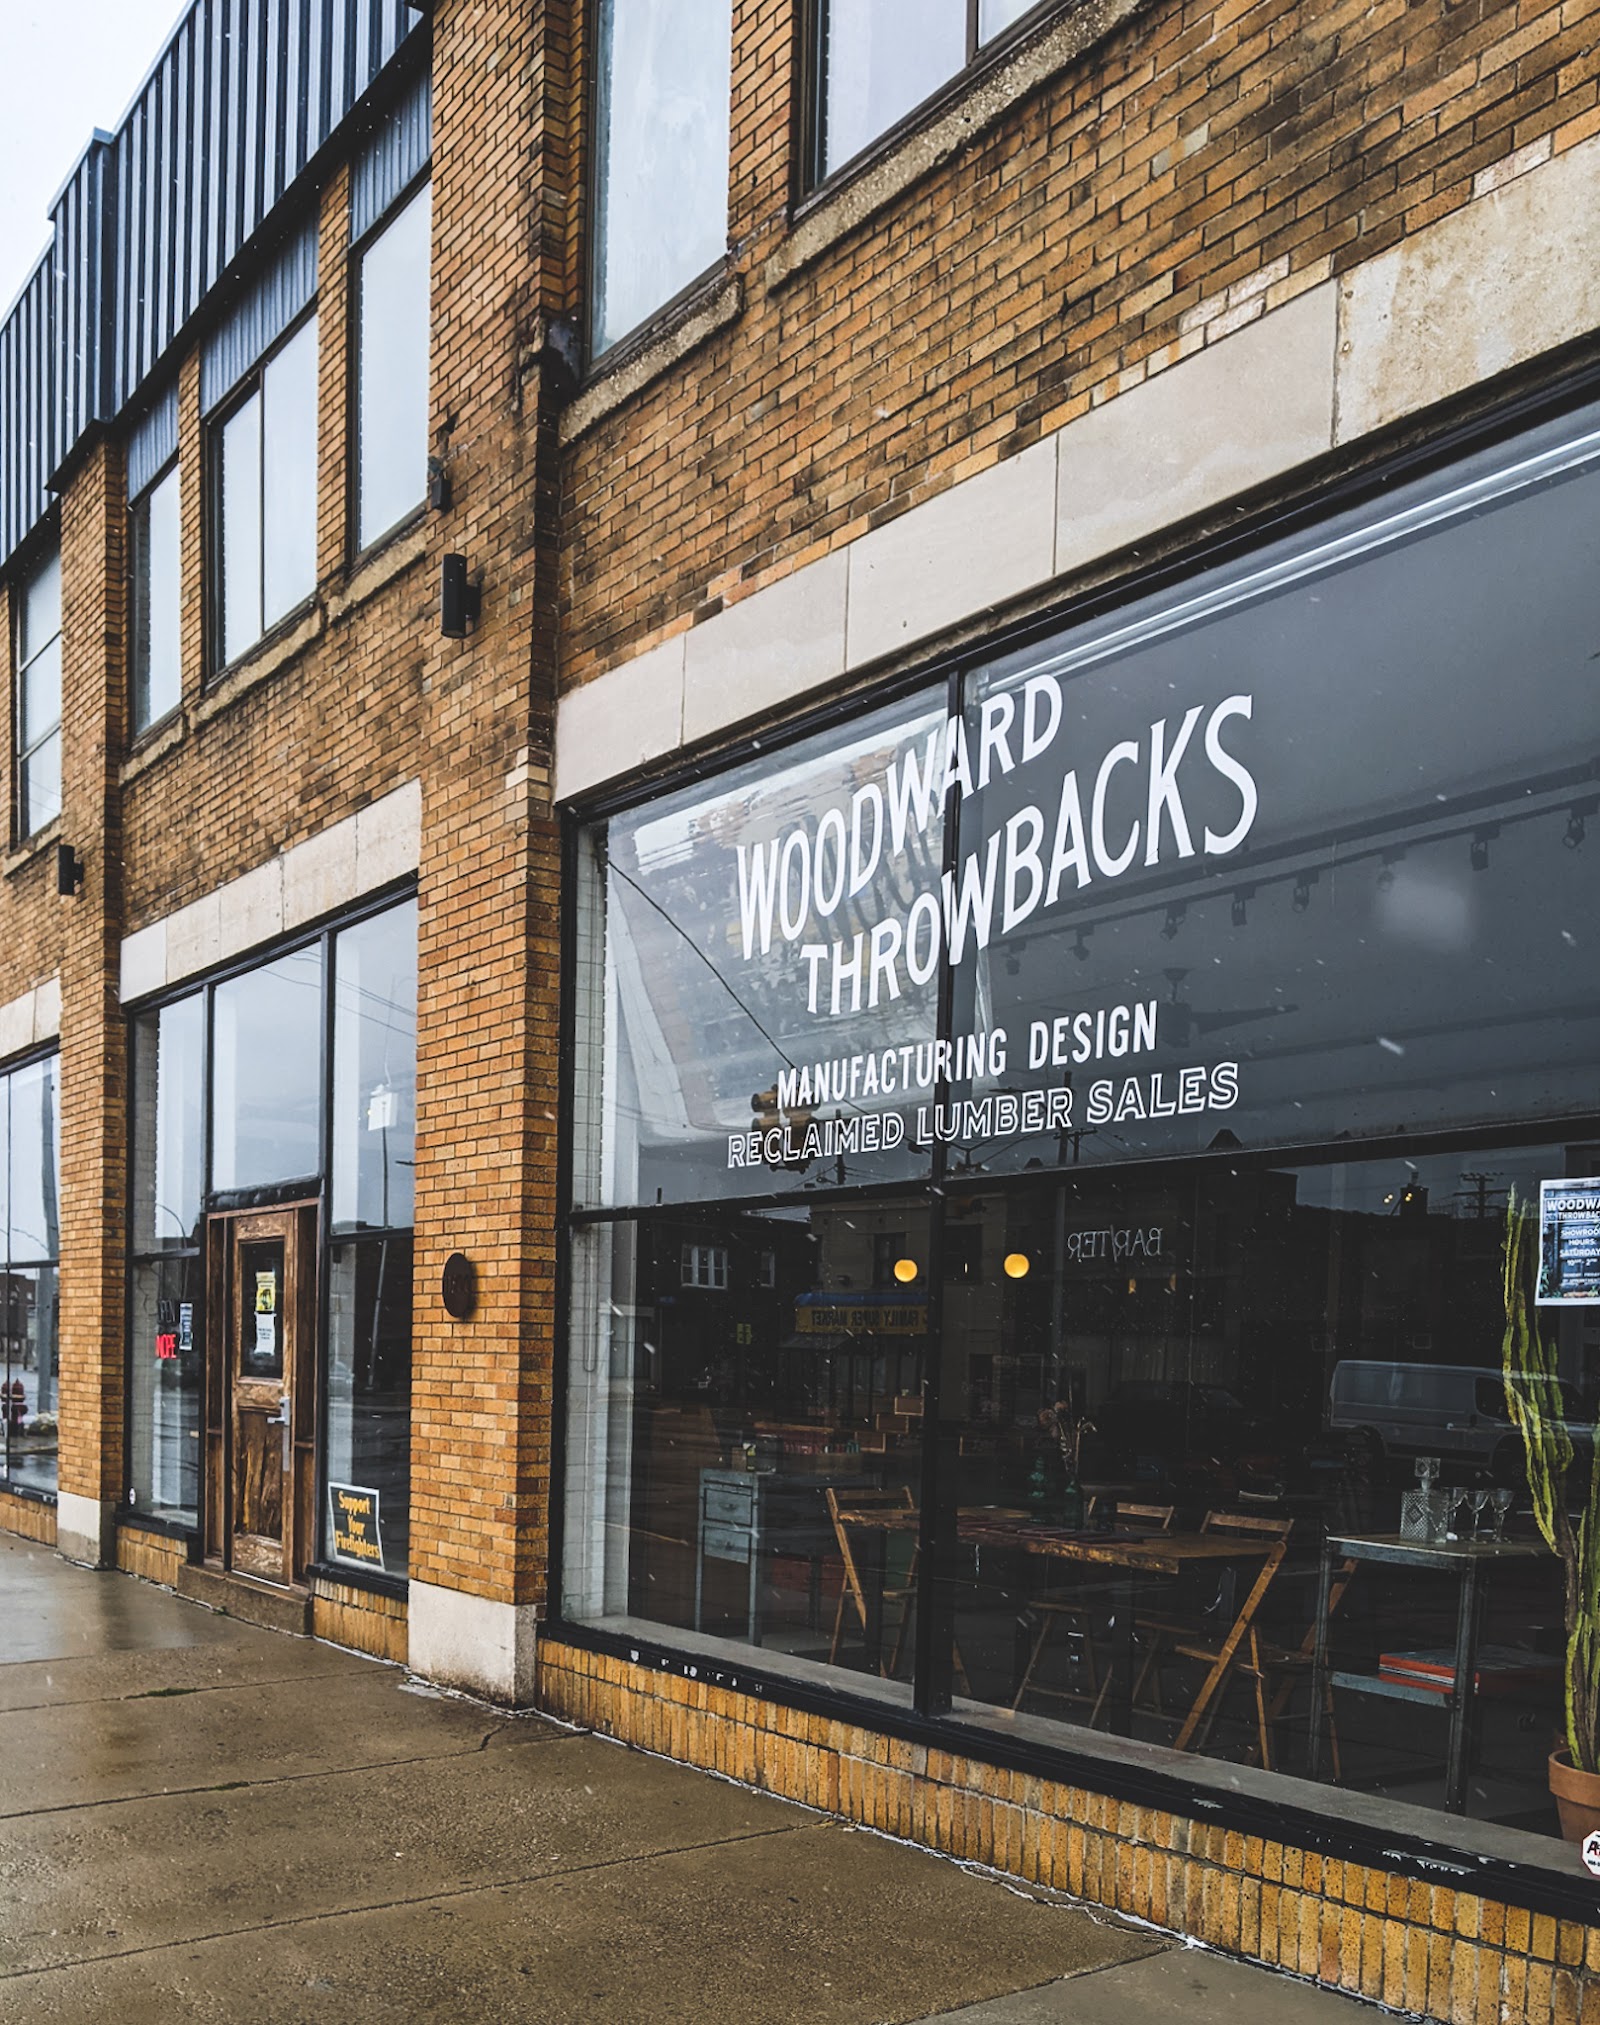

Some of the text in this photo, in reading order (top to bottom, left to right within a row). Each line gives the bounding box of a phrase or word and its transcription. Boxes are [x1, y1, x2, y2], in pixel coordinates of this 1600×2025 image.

[736, 674, 1063, 961] WOODWARD
[799, 694, 1258, 1015] THROWBACKS
[777, 1000, 1158, 1109] MANUFACTURING DESIGN
[727, 1061, 1239, 1168] RECLAIMED LUMBER SALES
[155, 1334, 177, 1359] NOPE
[338, 1490, 370, 1516] Support
[347, 1514, 365, 1536] Your
[335, 1530, 380, 1559] Firefighters
